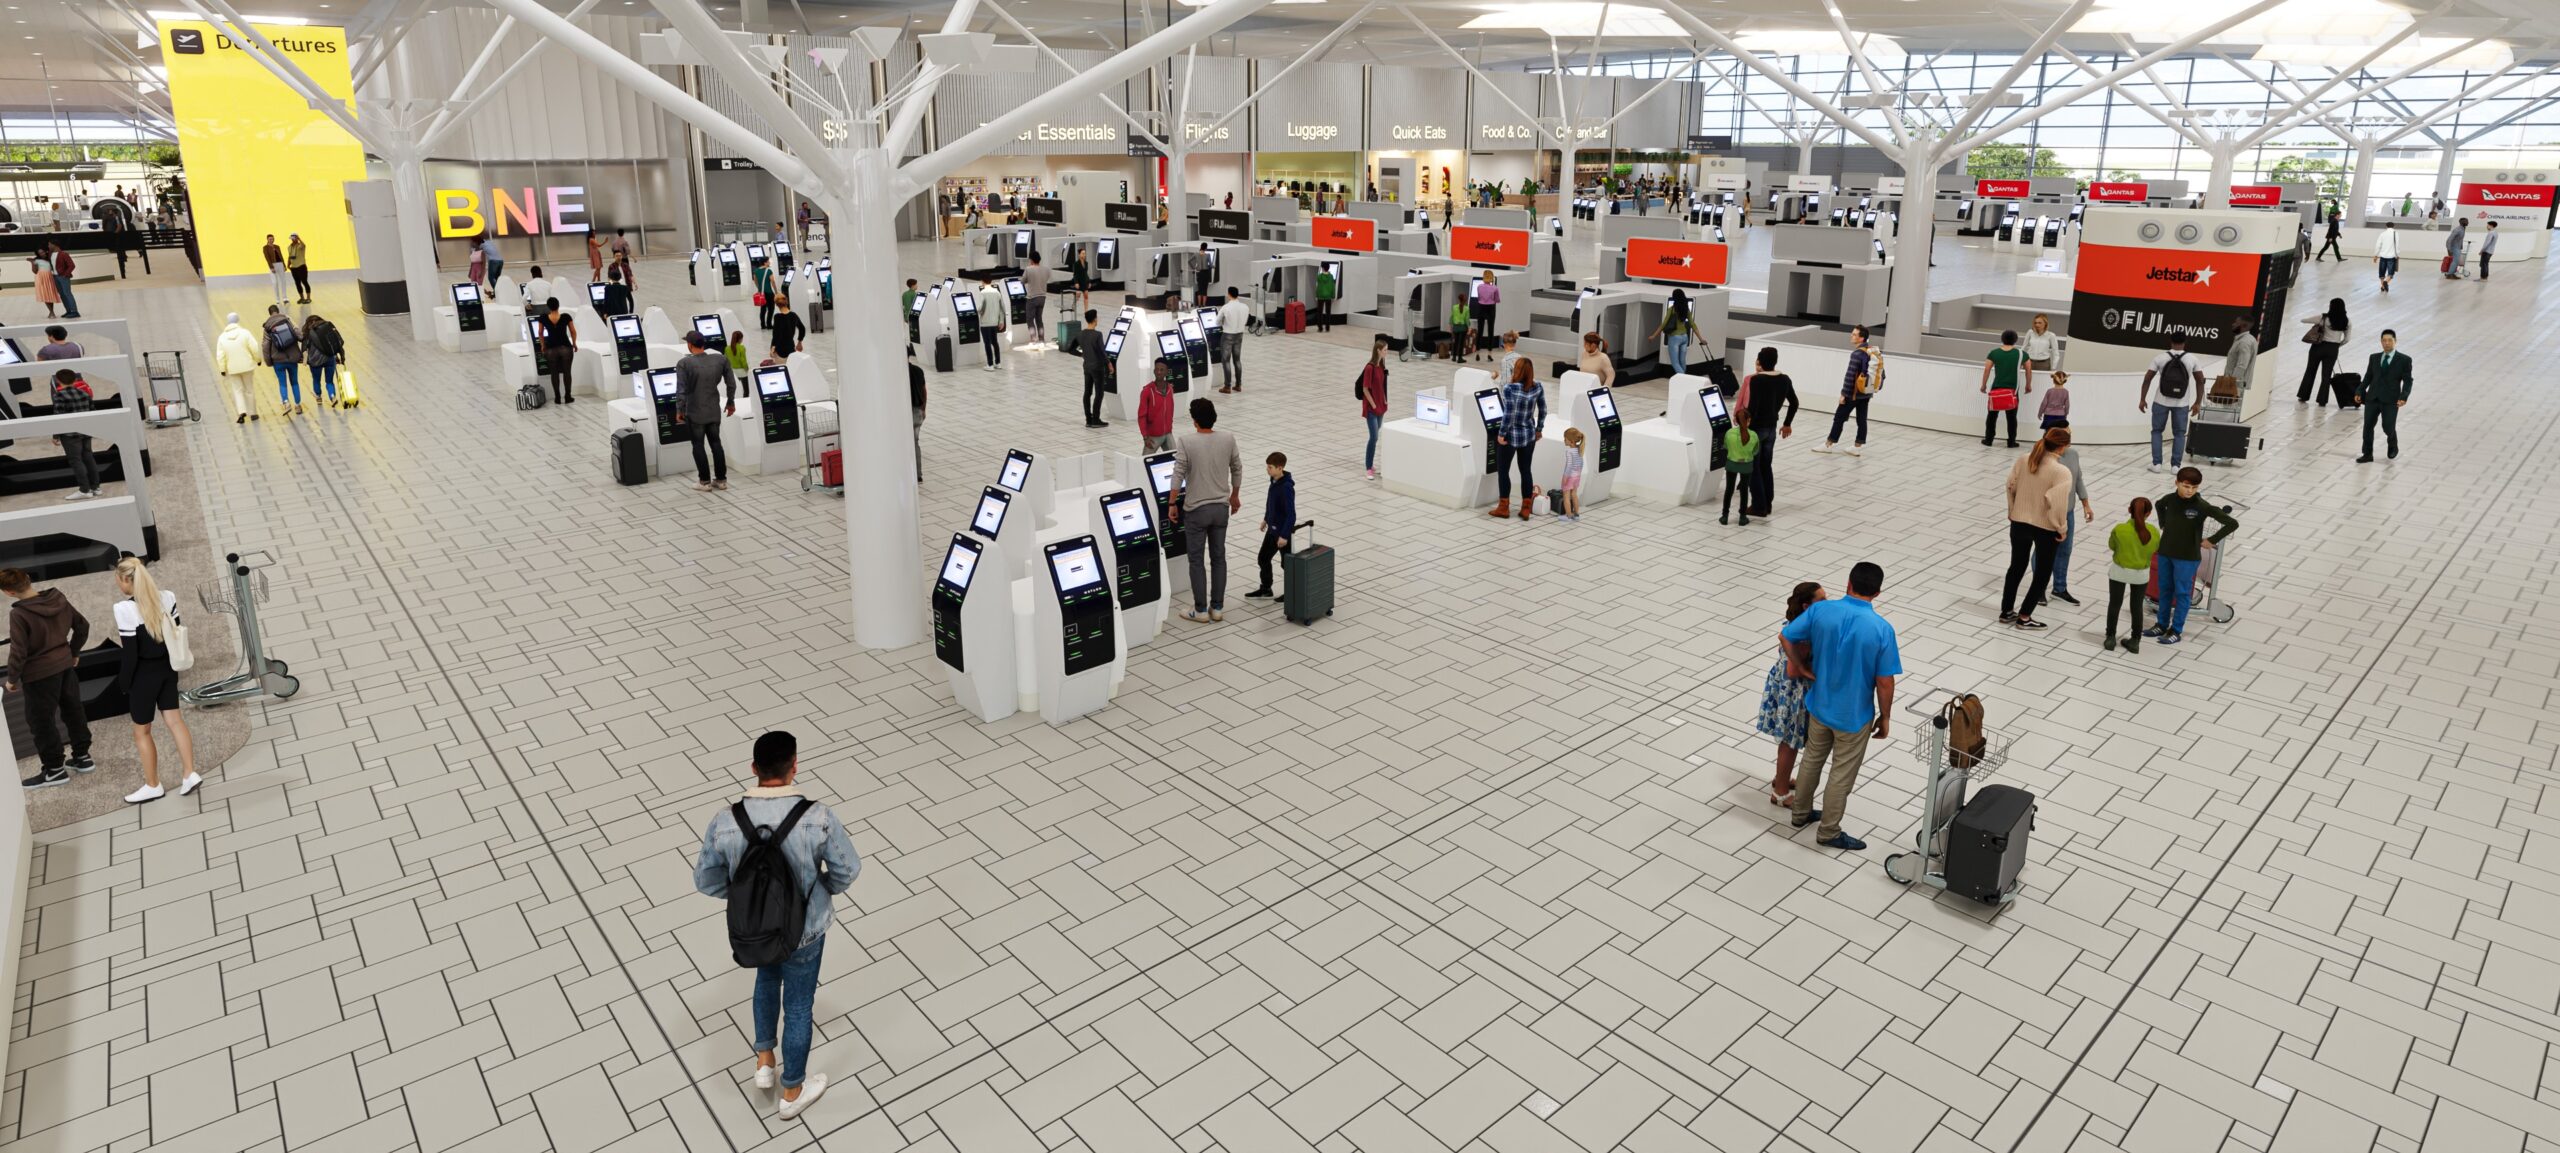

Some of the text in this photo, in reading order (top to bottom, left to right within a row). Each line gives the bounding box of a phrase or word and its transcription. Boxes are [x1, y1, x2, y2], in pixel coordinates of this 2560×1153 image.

[1038, 124, 1116, 141] Essentials
[1287, 122, 1338, 140] Luggage
[1392, 125, 1446, 139] Quick Eats
[1482, 125, 1532, 138] Food & Co.
[435, 186, 590, 238] BNE
[1658, 255, 1684, 265] Jetstar
[2146, 266, 2197, 282] Jetstar
[2121, 310, 2164, 333] FIJI
